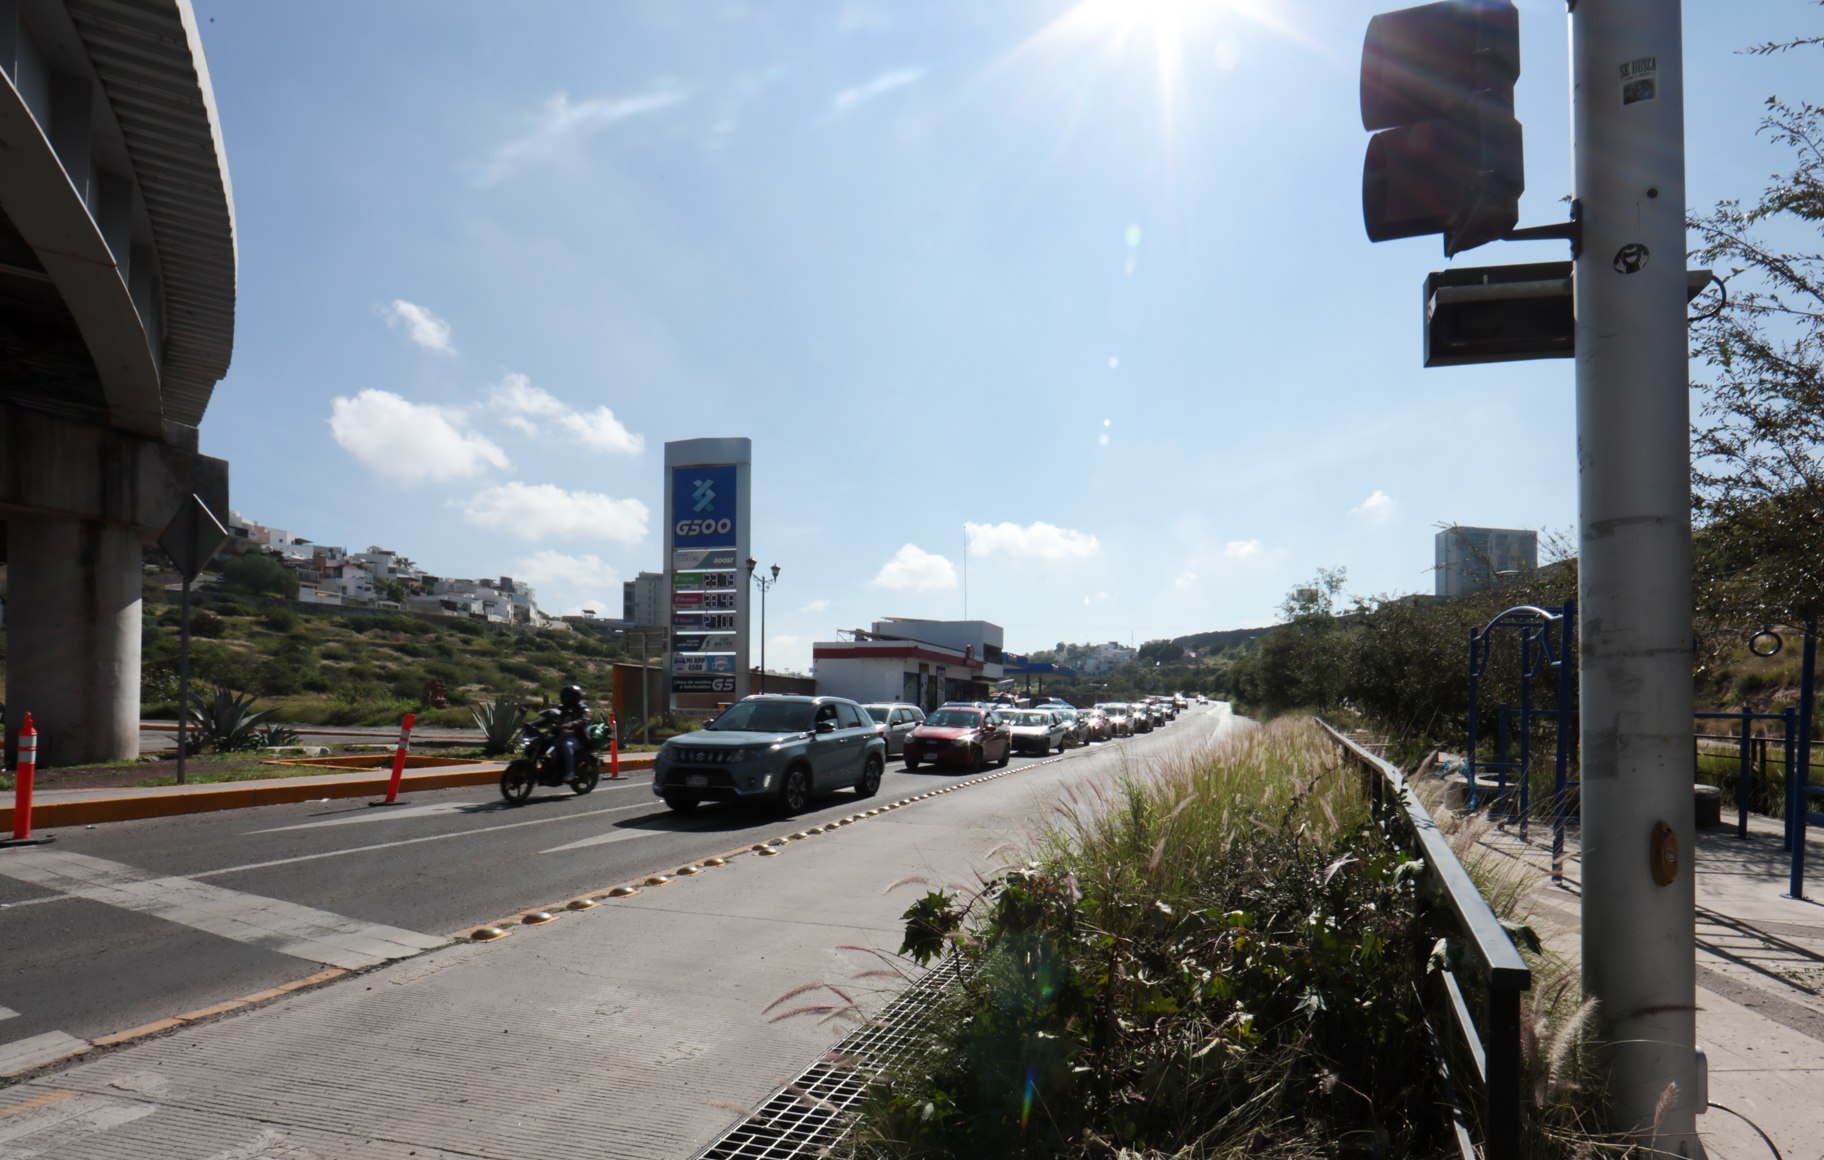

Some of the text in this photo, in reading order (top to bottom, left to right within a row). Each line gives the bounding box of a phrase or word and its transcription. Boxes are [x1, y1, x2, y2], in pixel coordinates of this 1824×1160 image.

[1620, 57, 1656, 78] SE BUSCA
[676, 518, 731, 536] G500
